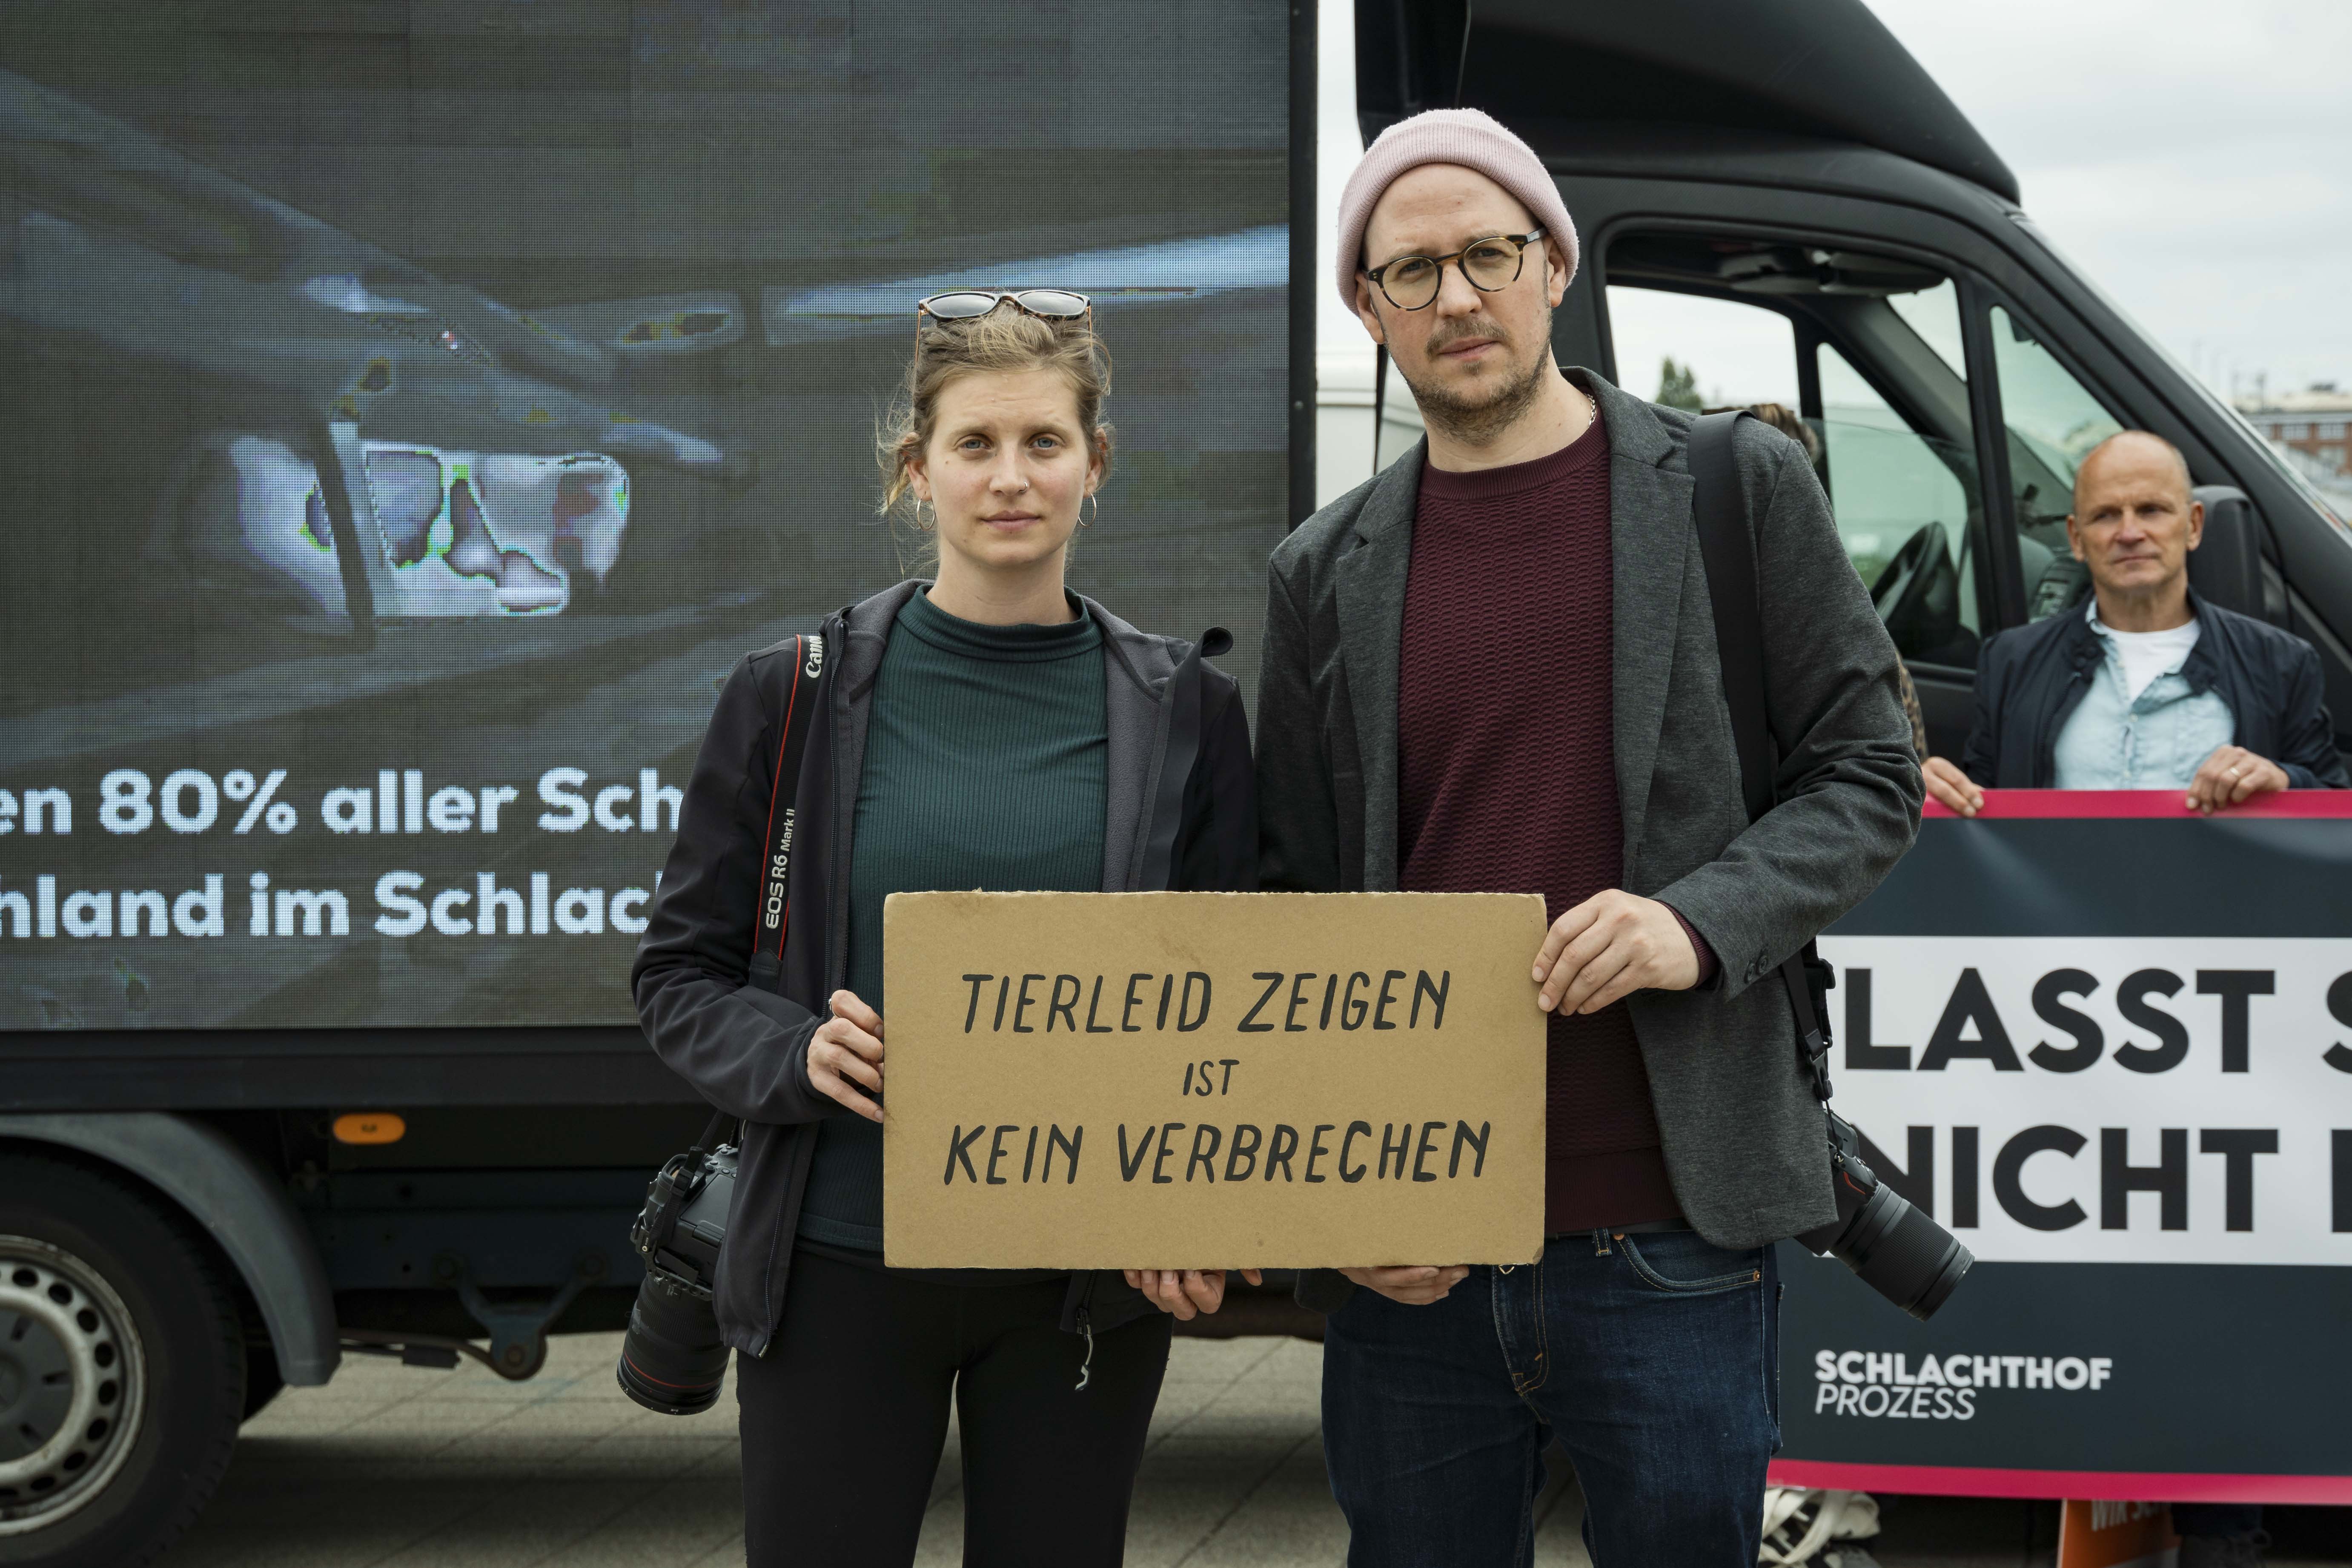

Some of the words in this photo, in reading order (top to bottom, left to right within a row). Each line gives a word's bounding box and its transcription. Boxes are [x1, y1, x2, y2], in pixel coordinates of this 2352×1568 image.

[99, 769, 298, 834] 80%
[321, 769, 519, 833] aller
[537, 766, 684, 832] Sch
[780, 819, 794, 851] Mark
[771, 855, 788, 878] R6
[249, 871, 350, 937] im
[374, 871, 663, 937] Schlac
[766, 882, 784, 929] EOS
[962, 971, 1212, 1034] TIERLEID
[1237, 970, 1450, 1032] ZEIGEN
[1845, 967, 2275, 1074] LASST
[1183, 1059, 1240, 1097] IST
[944, 1124, 1083, 1186] KEIN
[1117, 1120, 1491, 1184] VERBRECHEN
[1815, 1349, 2113, 1390] SCHLACHTHOF
[1815, 1383, 1977, 1420] PROZESS
